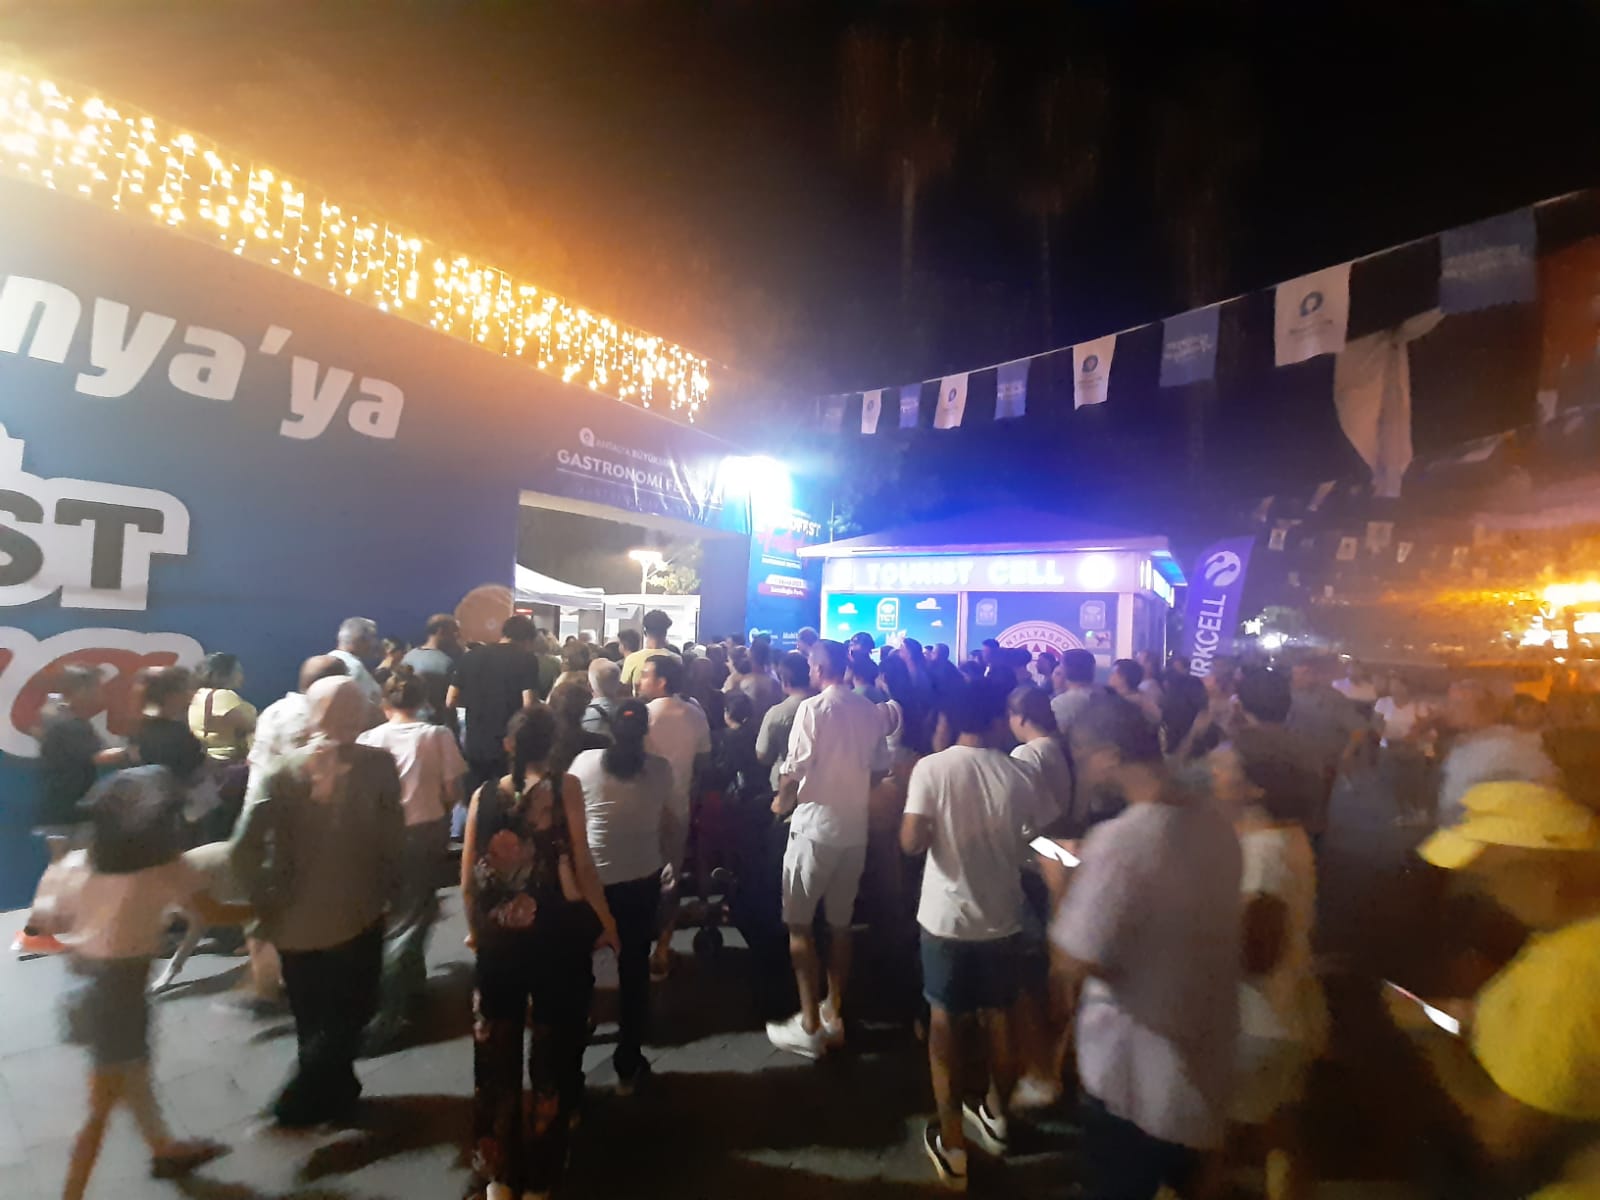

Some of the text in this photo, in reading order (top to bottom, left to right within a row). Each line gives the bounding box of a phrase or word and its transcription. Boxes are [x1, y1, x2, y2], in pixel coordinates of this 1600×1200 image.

[867, 560, 1065, 585] TOURIST CELL
[1004, 629, 1071, 650] NTALYASPO
